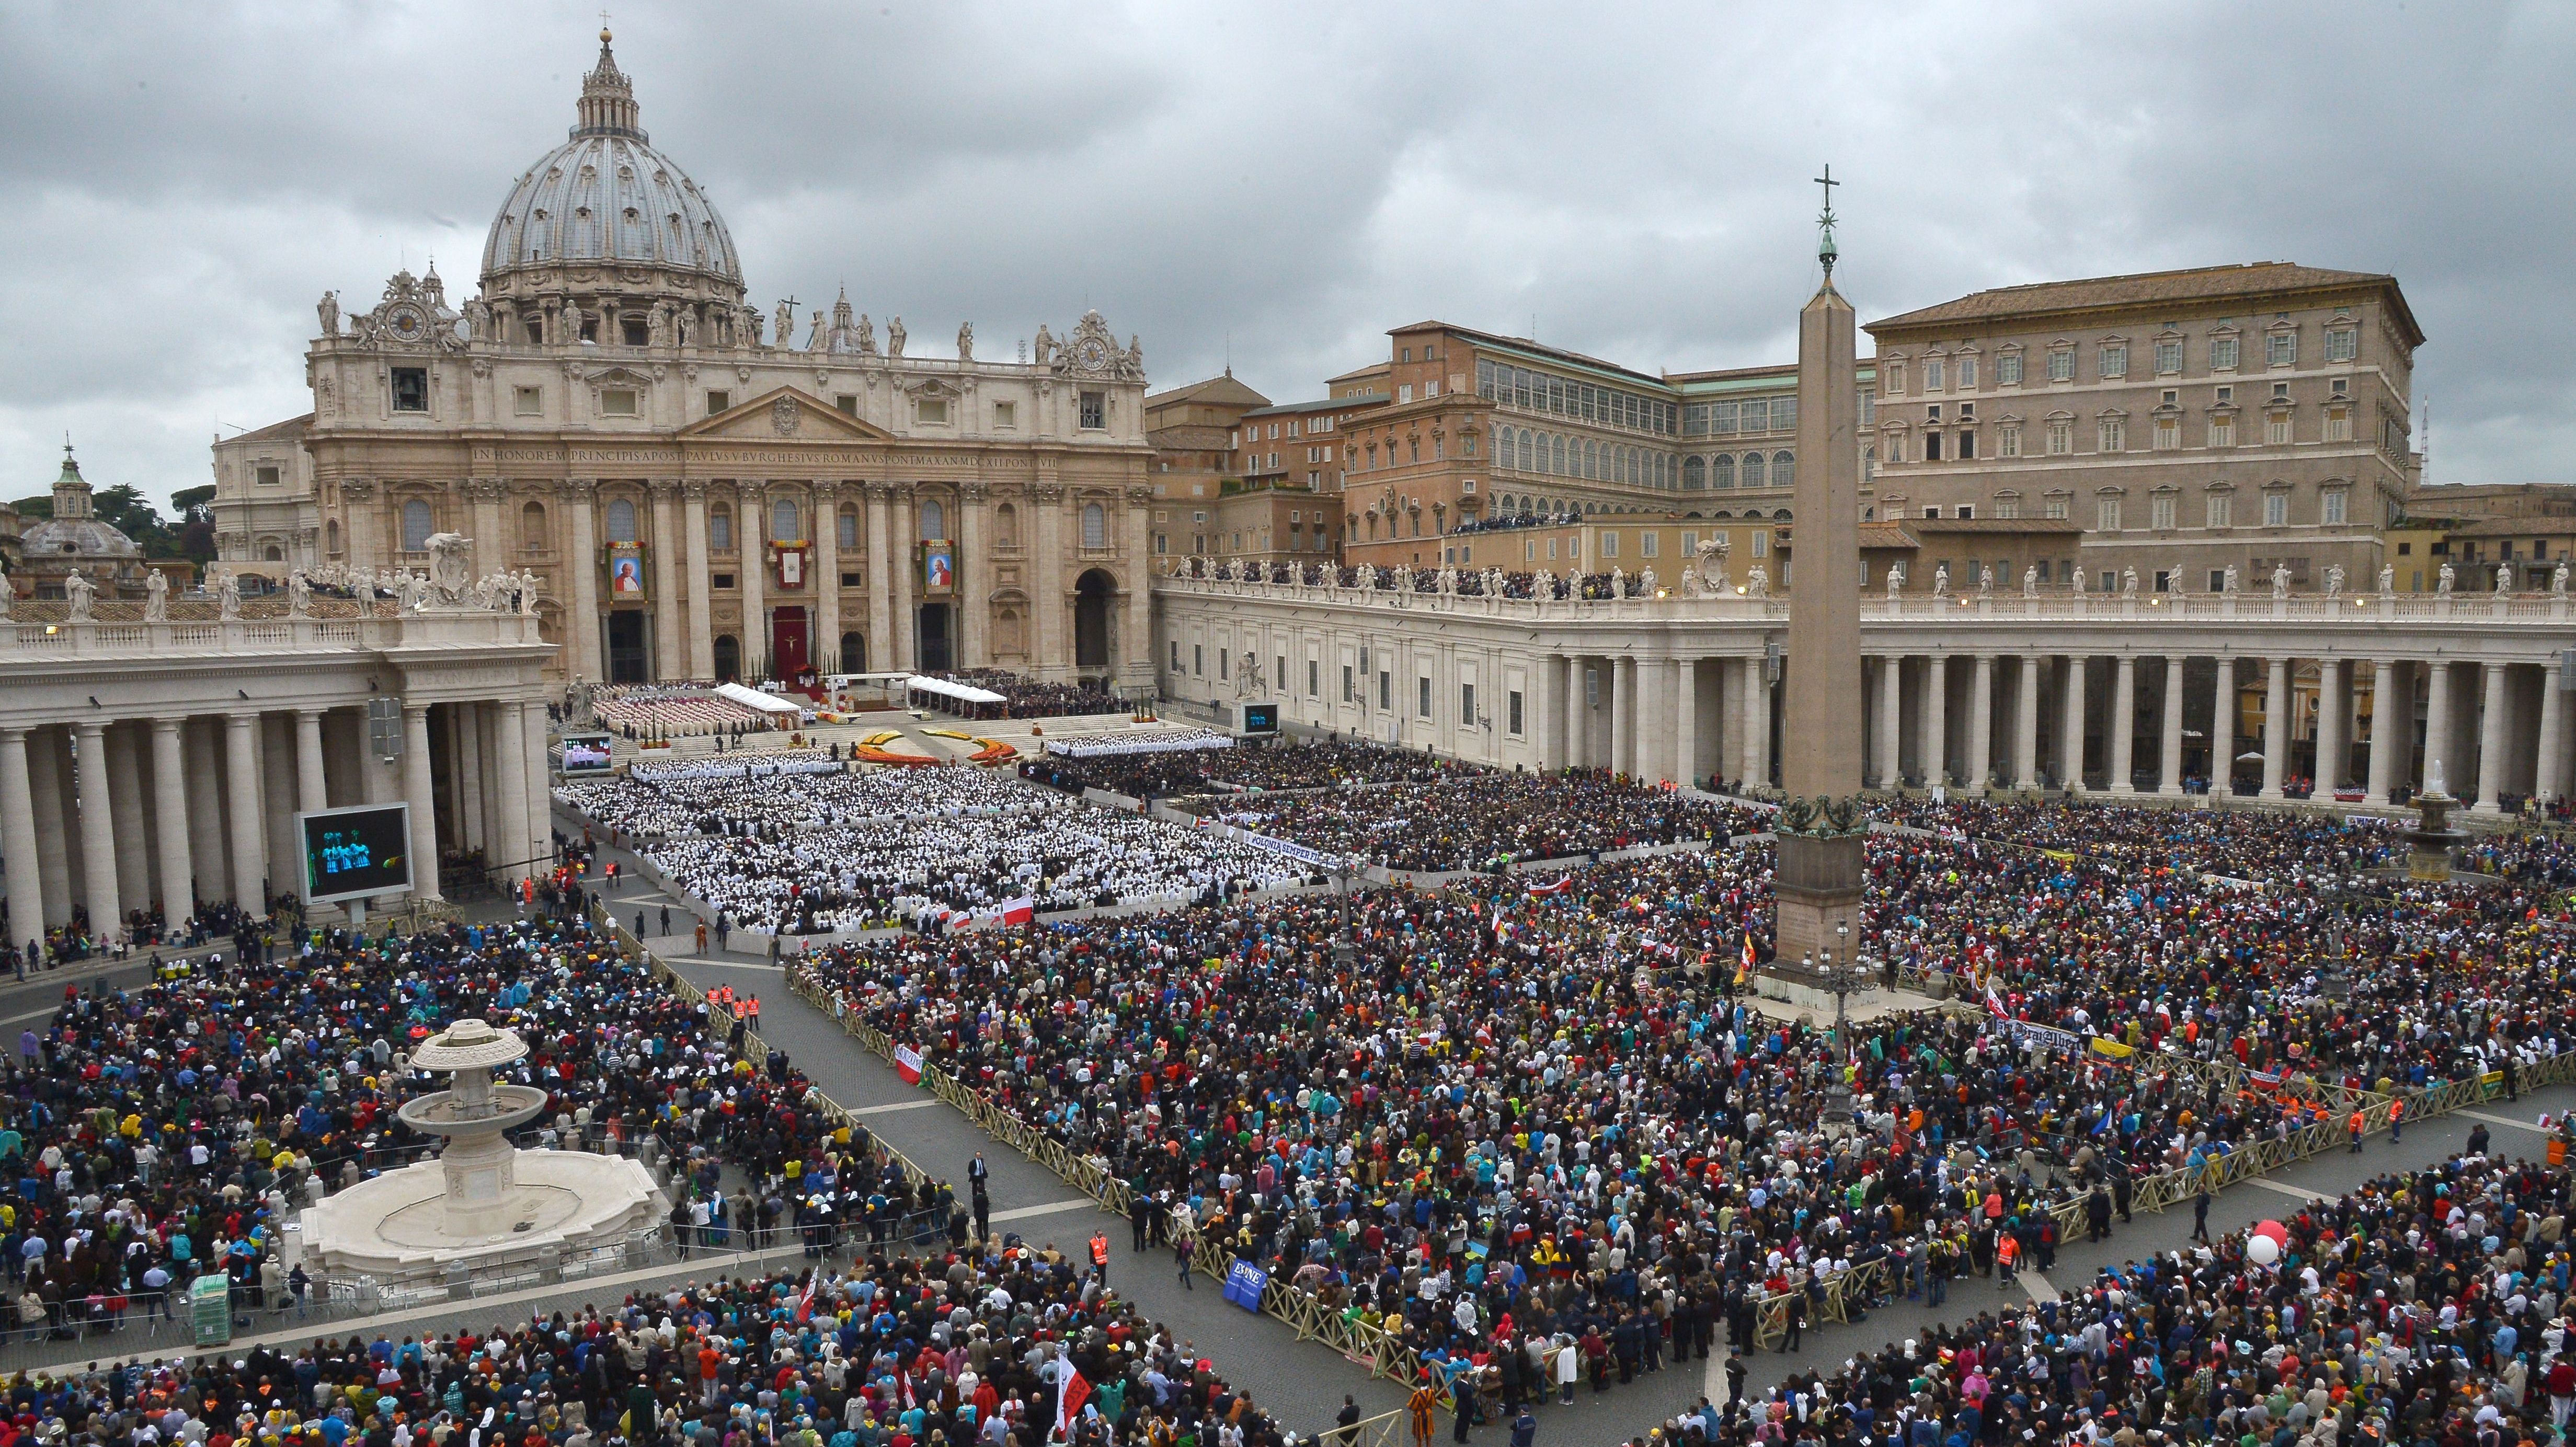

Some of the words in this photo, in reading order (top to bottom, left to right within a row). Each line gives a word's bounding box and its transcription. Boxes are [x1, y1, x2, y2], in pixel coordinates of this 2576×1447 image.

[474, 449, 489, 459] IN
[495, 450, 565, 461] HONOREM
[571, 451, 639, 461] PRINCIPIS
[642, 451, 682, 461] APOST
[686, 451, 729, 461] PAVLVS
[732, 452, 738, 461] V
[742, 452, 819, 463] BVRGHESIVS
[823, 453, 884, 464] ROMANVS
[1039, 458, 1056, 467] VII
[1252, 836, 1280, 851] POLONIA
[1282, 844, 1309, 858] SEMPER
